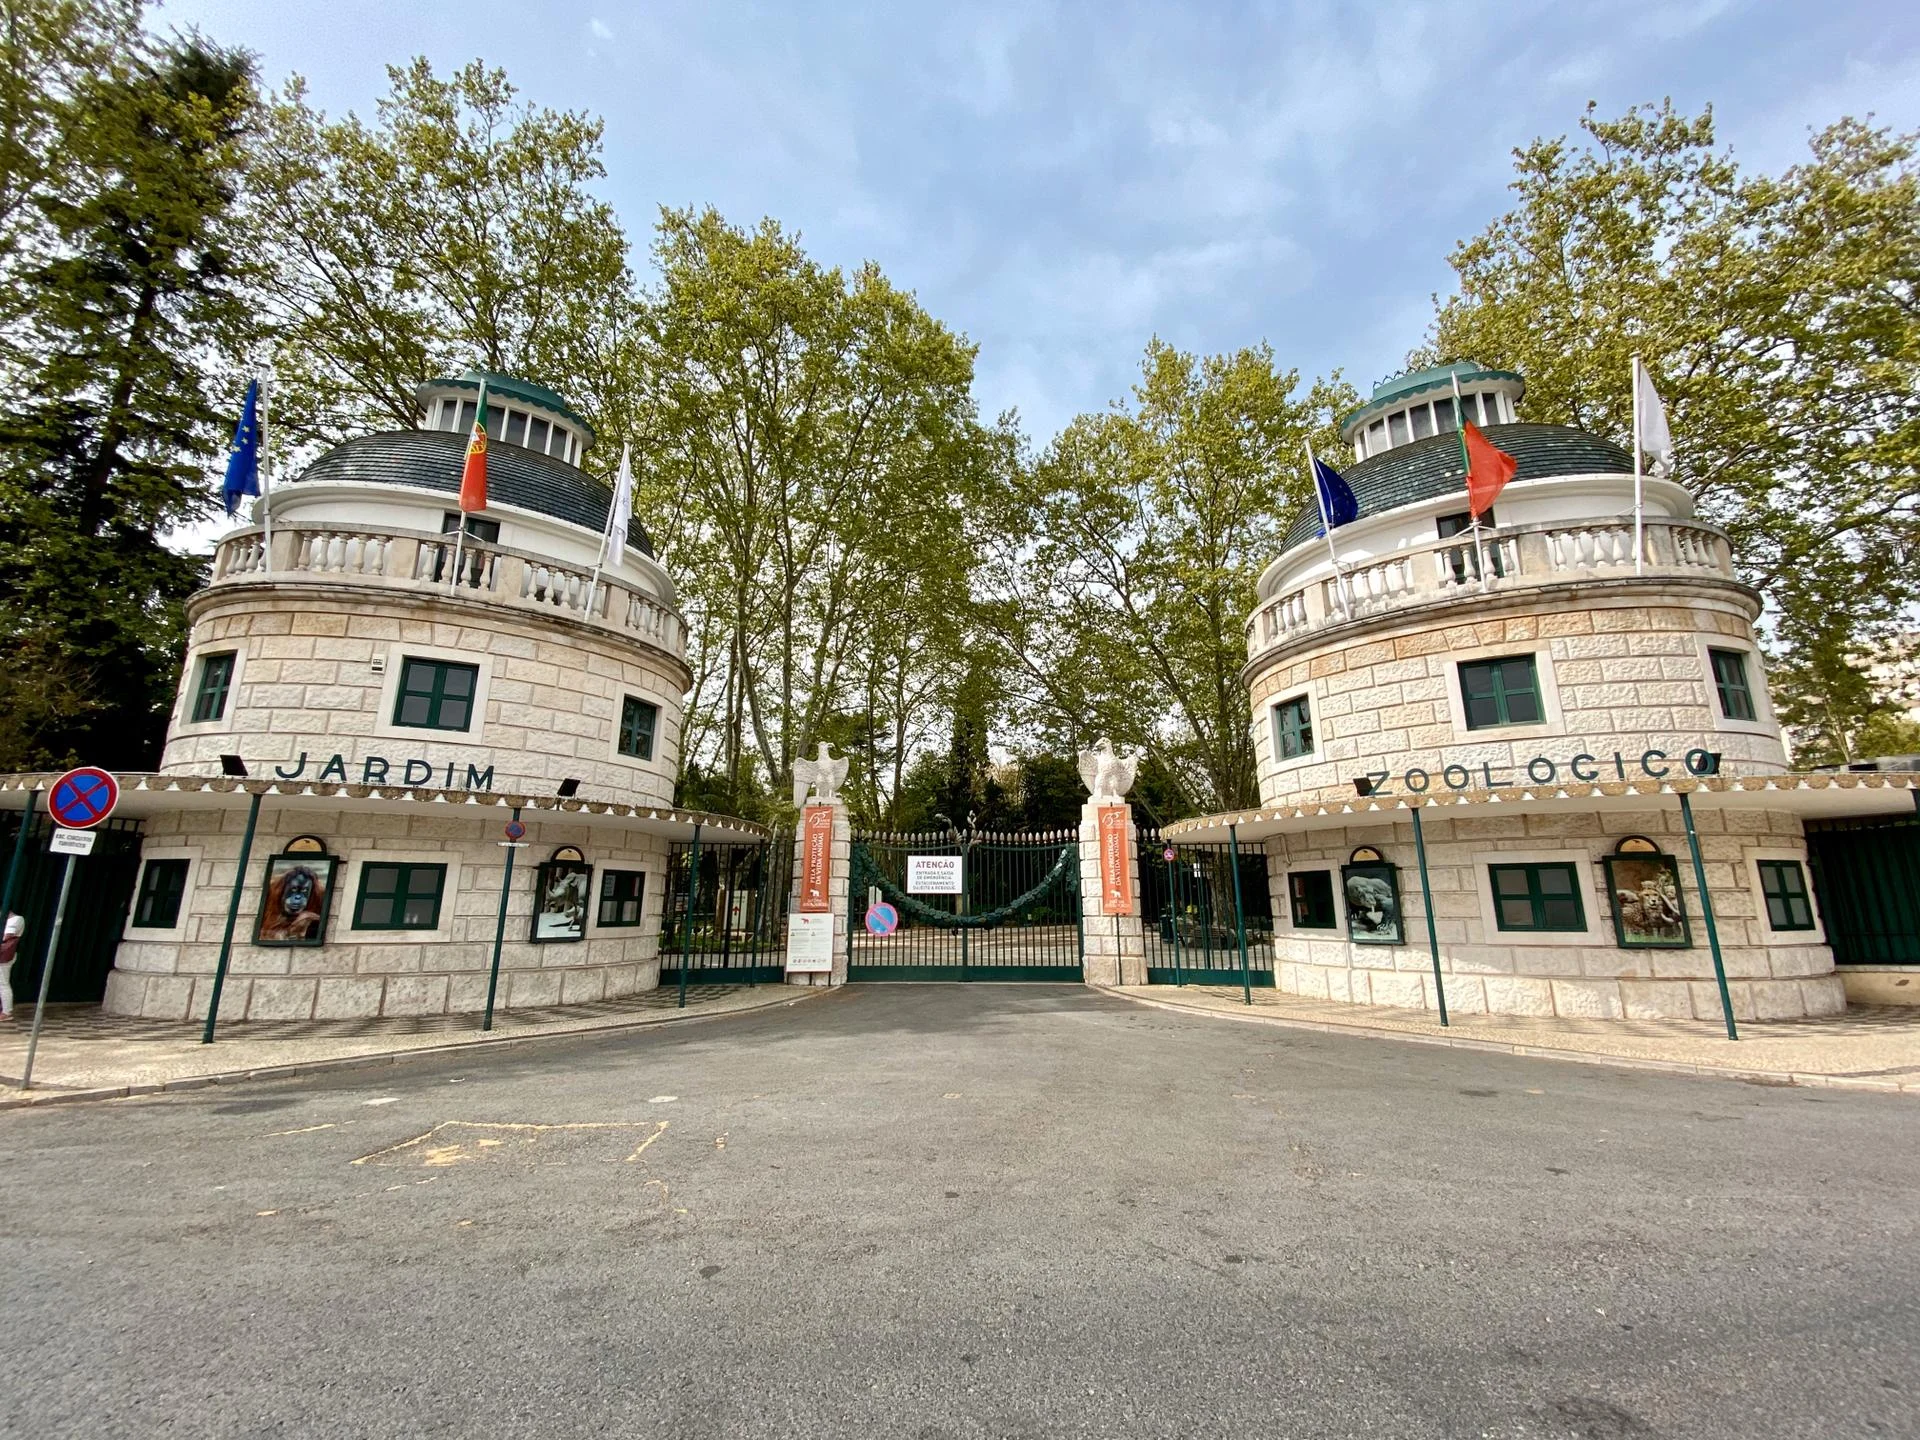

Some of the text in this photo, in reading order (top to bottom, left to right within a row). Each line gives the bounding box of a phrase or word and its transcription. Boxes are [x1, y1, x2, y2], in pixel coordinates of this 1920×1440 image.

[275, 752, 495, 791] JARDIM
[1366, 748, 1715, 796] ZOOLÓGICO
[916, 860, 954, 869] ATENÇÃO
[816, 876, 821, 884] DA
[1115, 876, 1121, 886] DA
